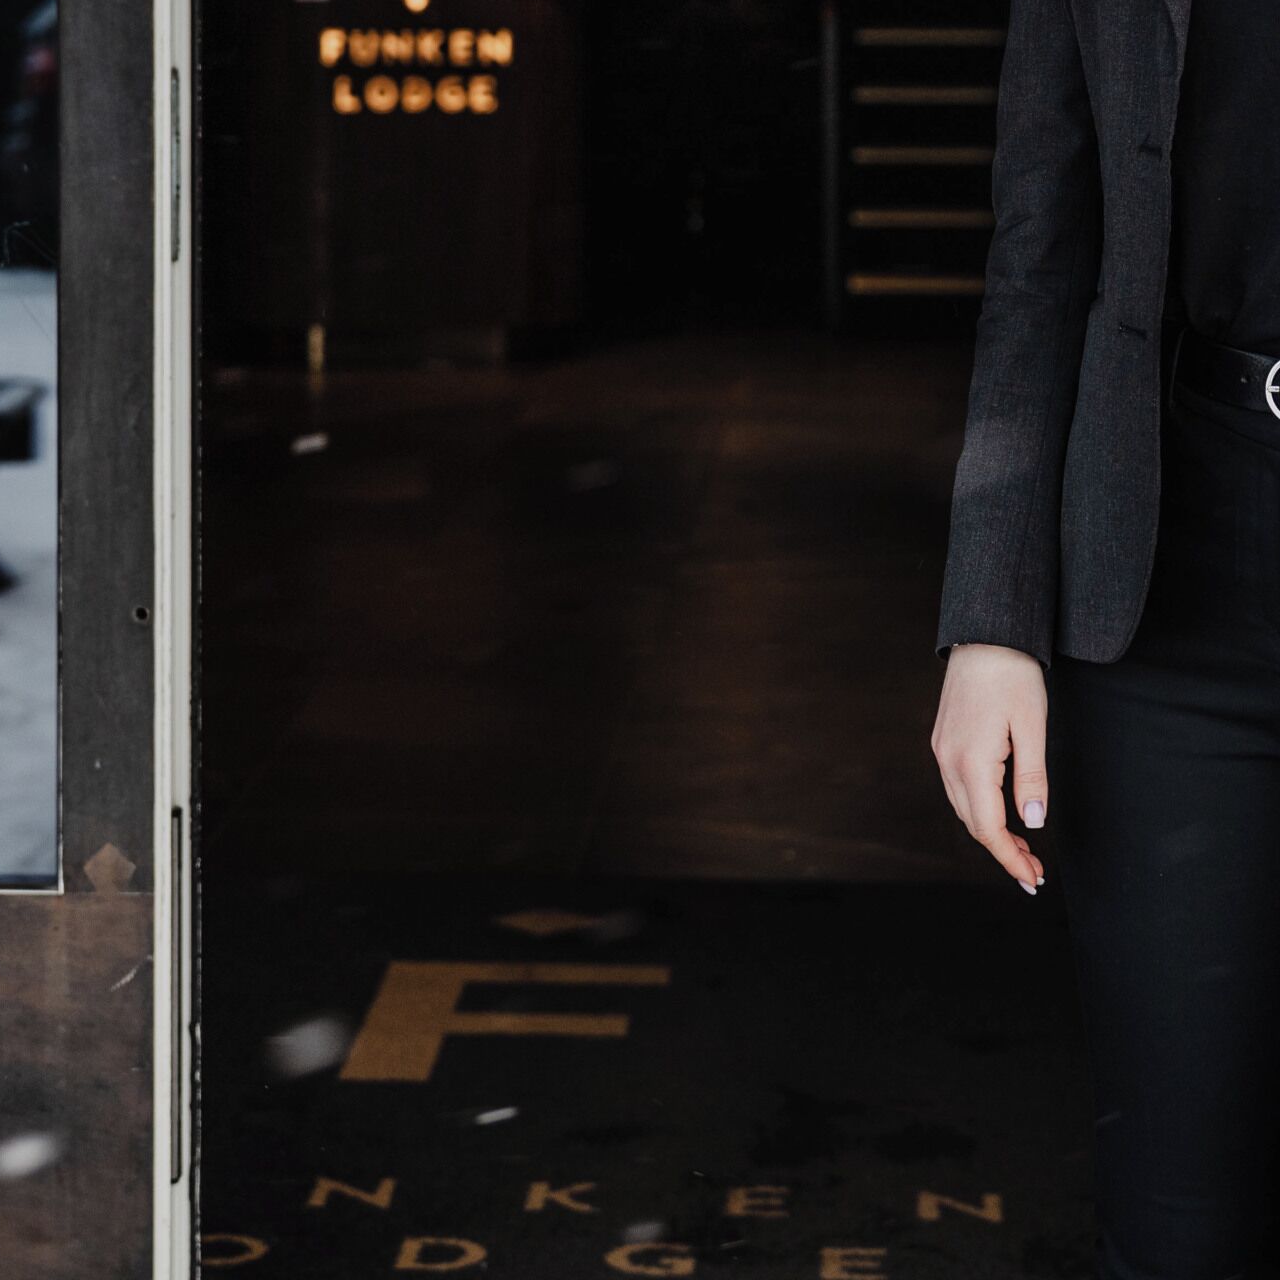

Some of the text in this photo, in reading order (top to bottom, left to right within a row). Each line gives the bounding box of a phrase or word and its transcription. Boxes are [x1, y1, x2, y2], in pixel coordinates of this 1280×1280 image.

[319, 27, 513, 67] FUNKEN
[331, 74, 499, 114] LODGE
[338, 961, 671, 1082] F
